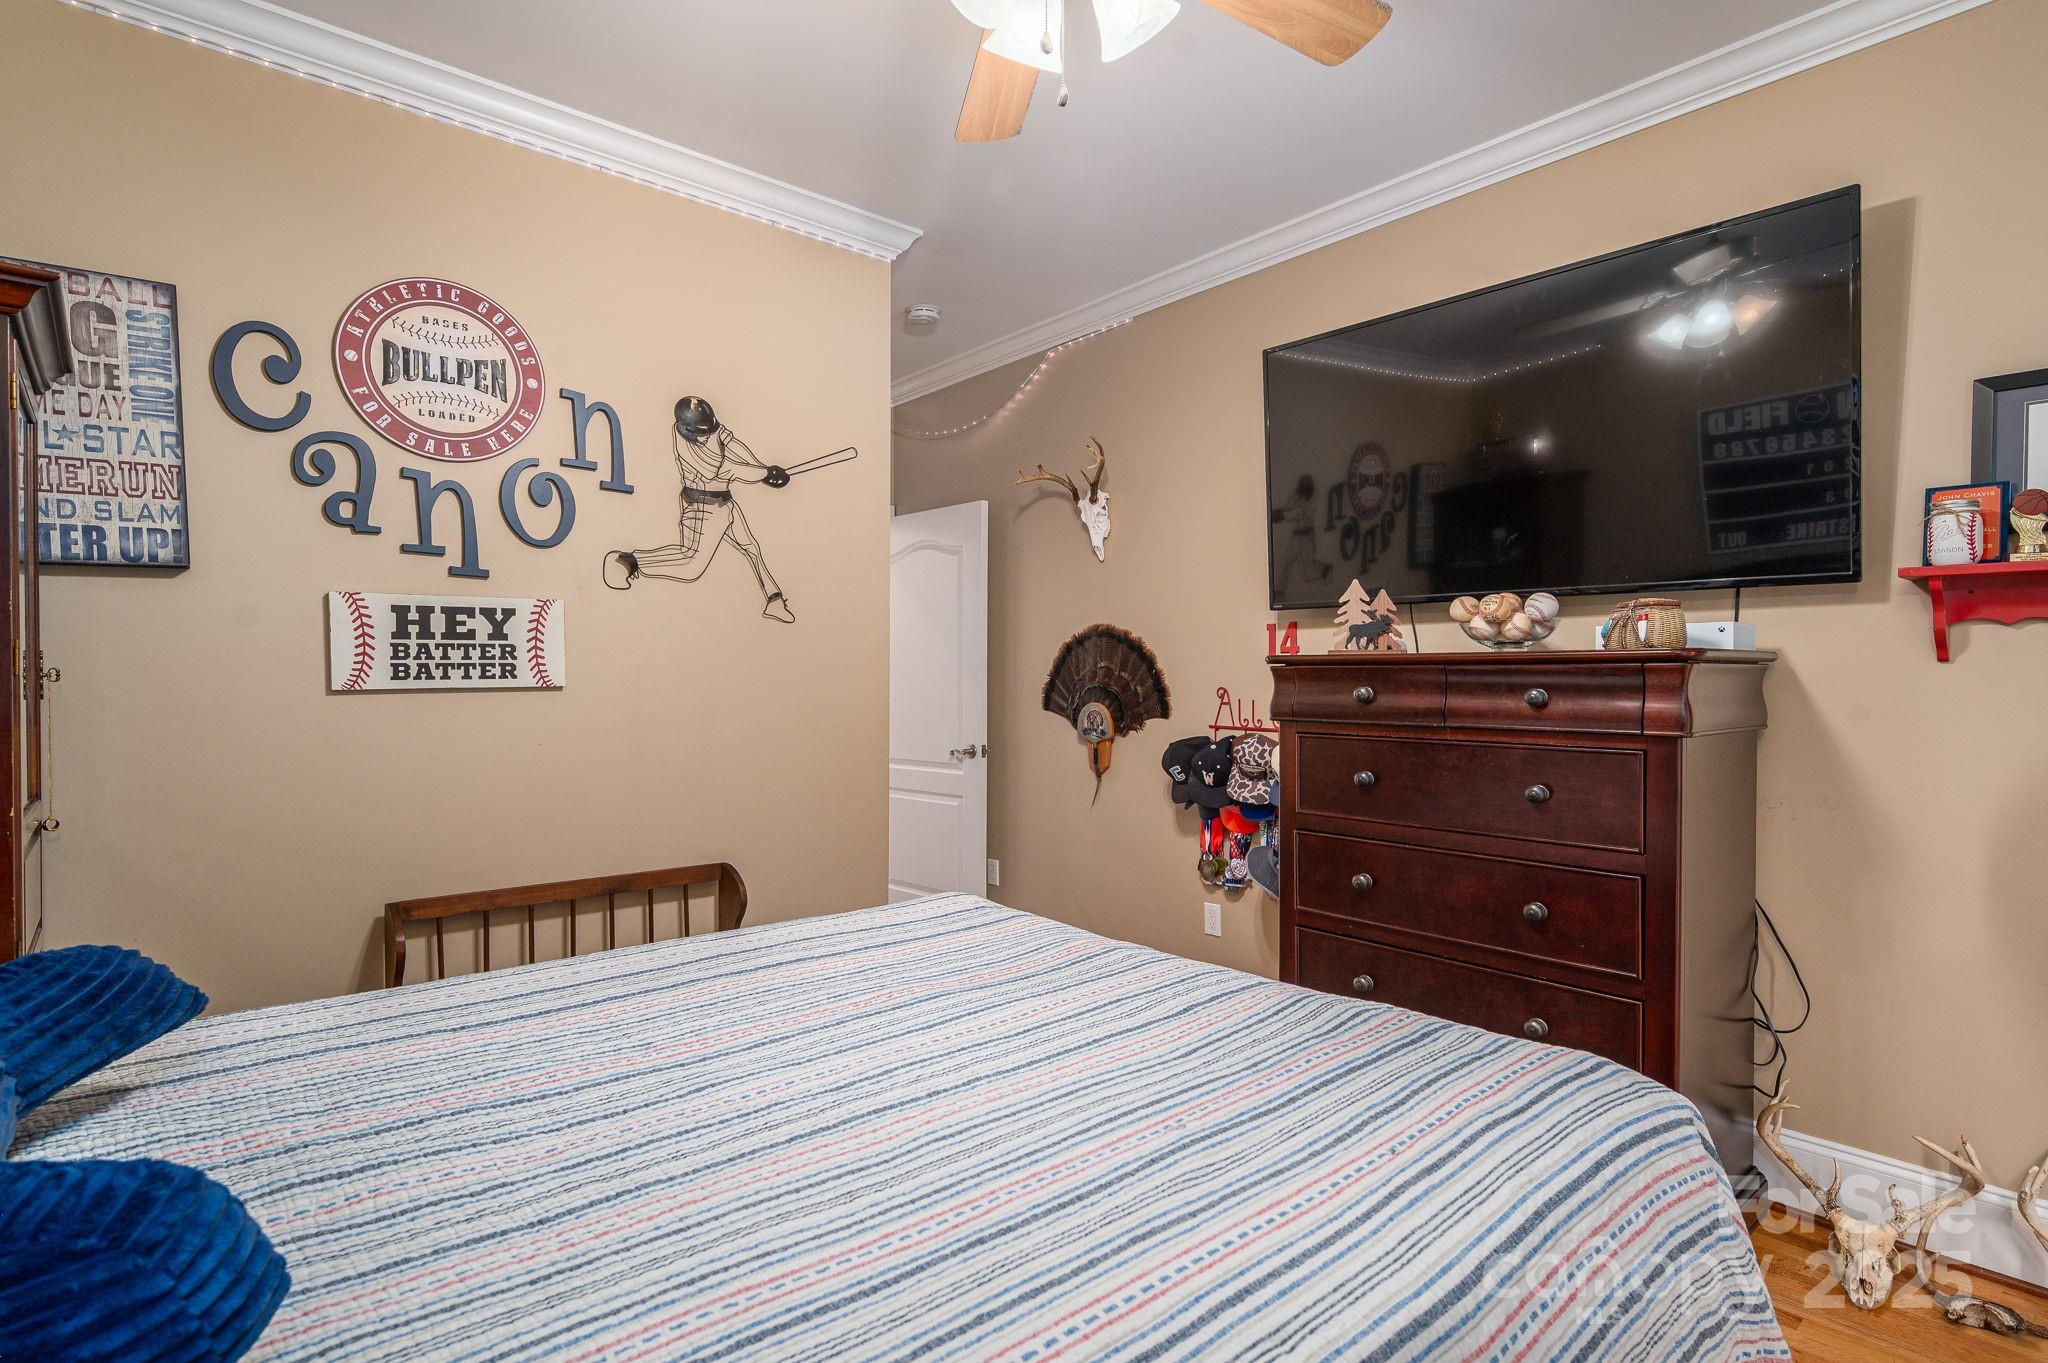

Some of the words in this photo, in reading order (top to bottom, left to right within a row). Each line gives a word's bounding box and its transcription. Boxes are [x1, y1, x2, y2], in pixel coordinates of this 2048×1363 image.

[67, 271, 172, 309] BALL
[346, 283, 460, 338] ATHLETIC
[477, 301, 536, 366] GOODS
[421, 315, 469, 332] BASES
[125, 308, 173, 383] STRIKE
[381, 338, 508, 403] BULLPEN
[78, 391, 126, 421] DAY
[129, 383, 176, 425] ONE
[352, 386, 392, 428] FOR
[405, 431, 471, 457] SALE
[486, 408, 534, 450] HERE
[418, 408, 476, 423] LOADED
[83, 424, 182, 460] STAR
[1963, 490, 1995, 498] CHAVIS
[94, 501, 181, 524] SLAM
[119, 527, 183, 563] UP!
[390, 604, 517, 642] HEY
[1266, 621, 1300, 656] 14
[389, 642, 518, 661] BATTER
[389, 662, 518, 681] BATTER
[1169, 765, 1186, 783] C
[1202, 770, 1215, 786] W
